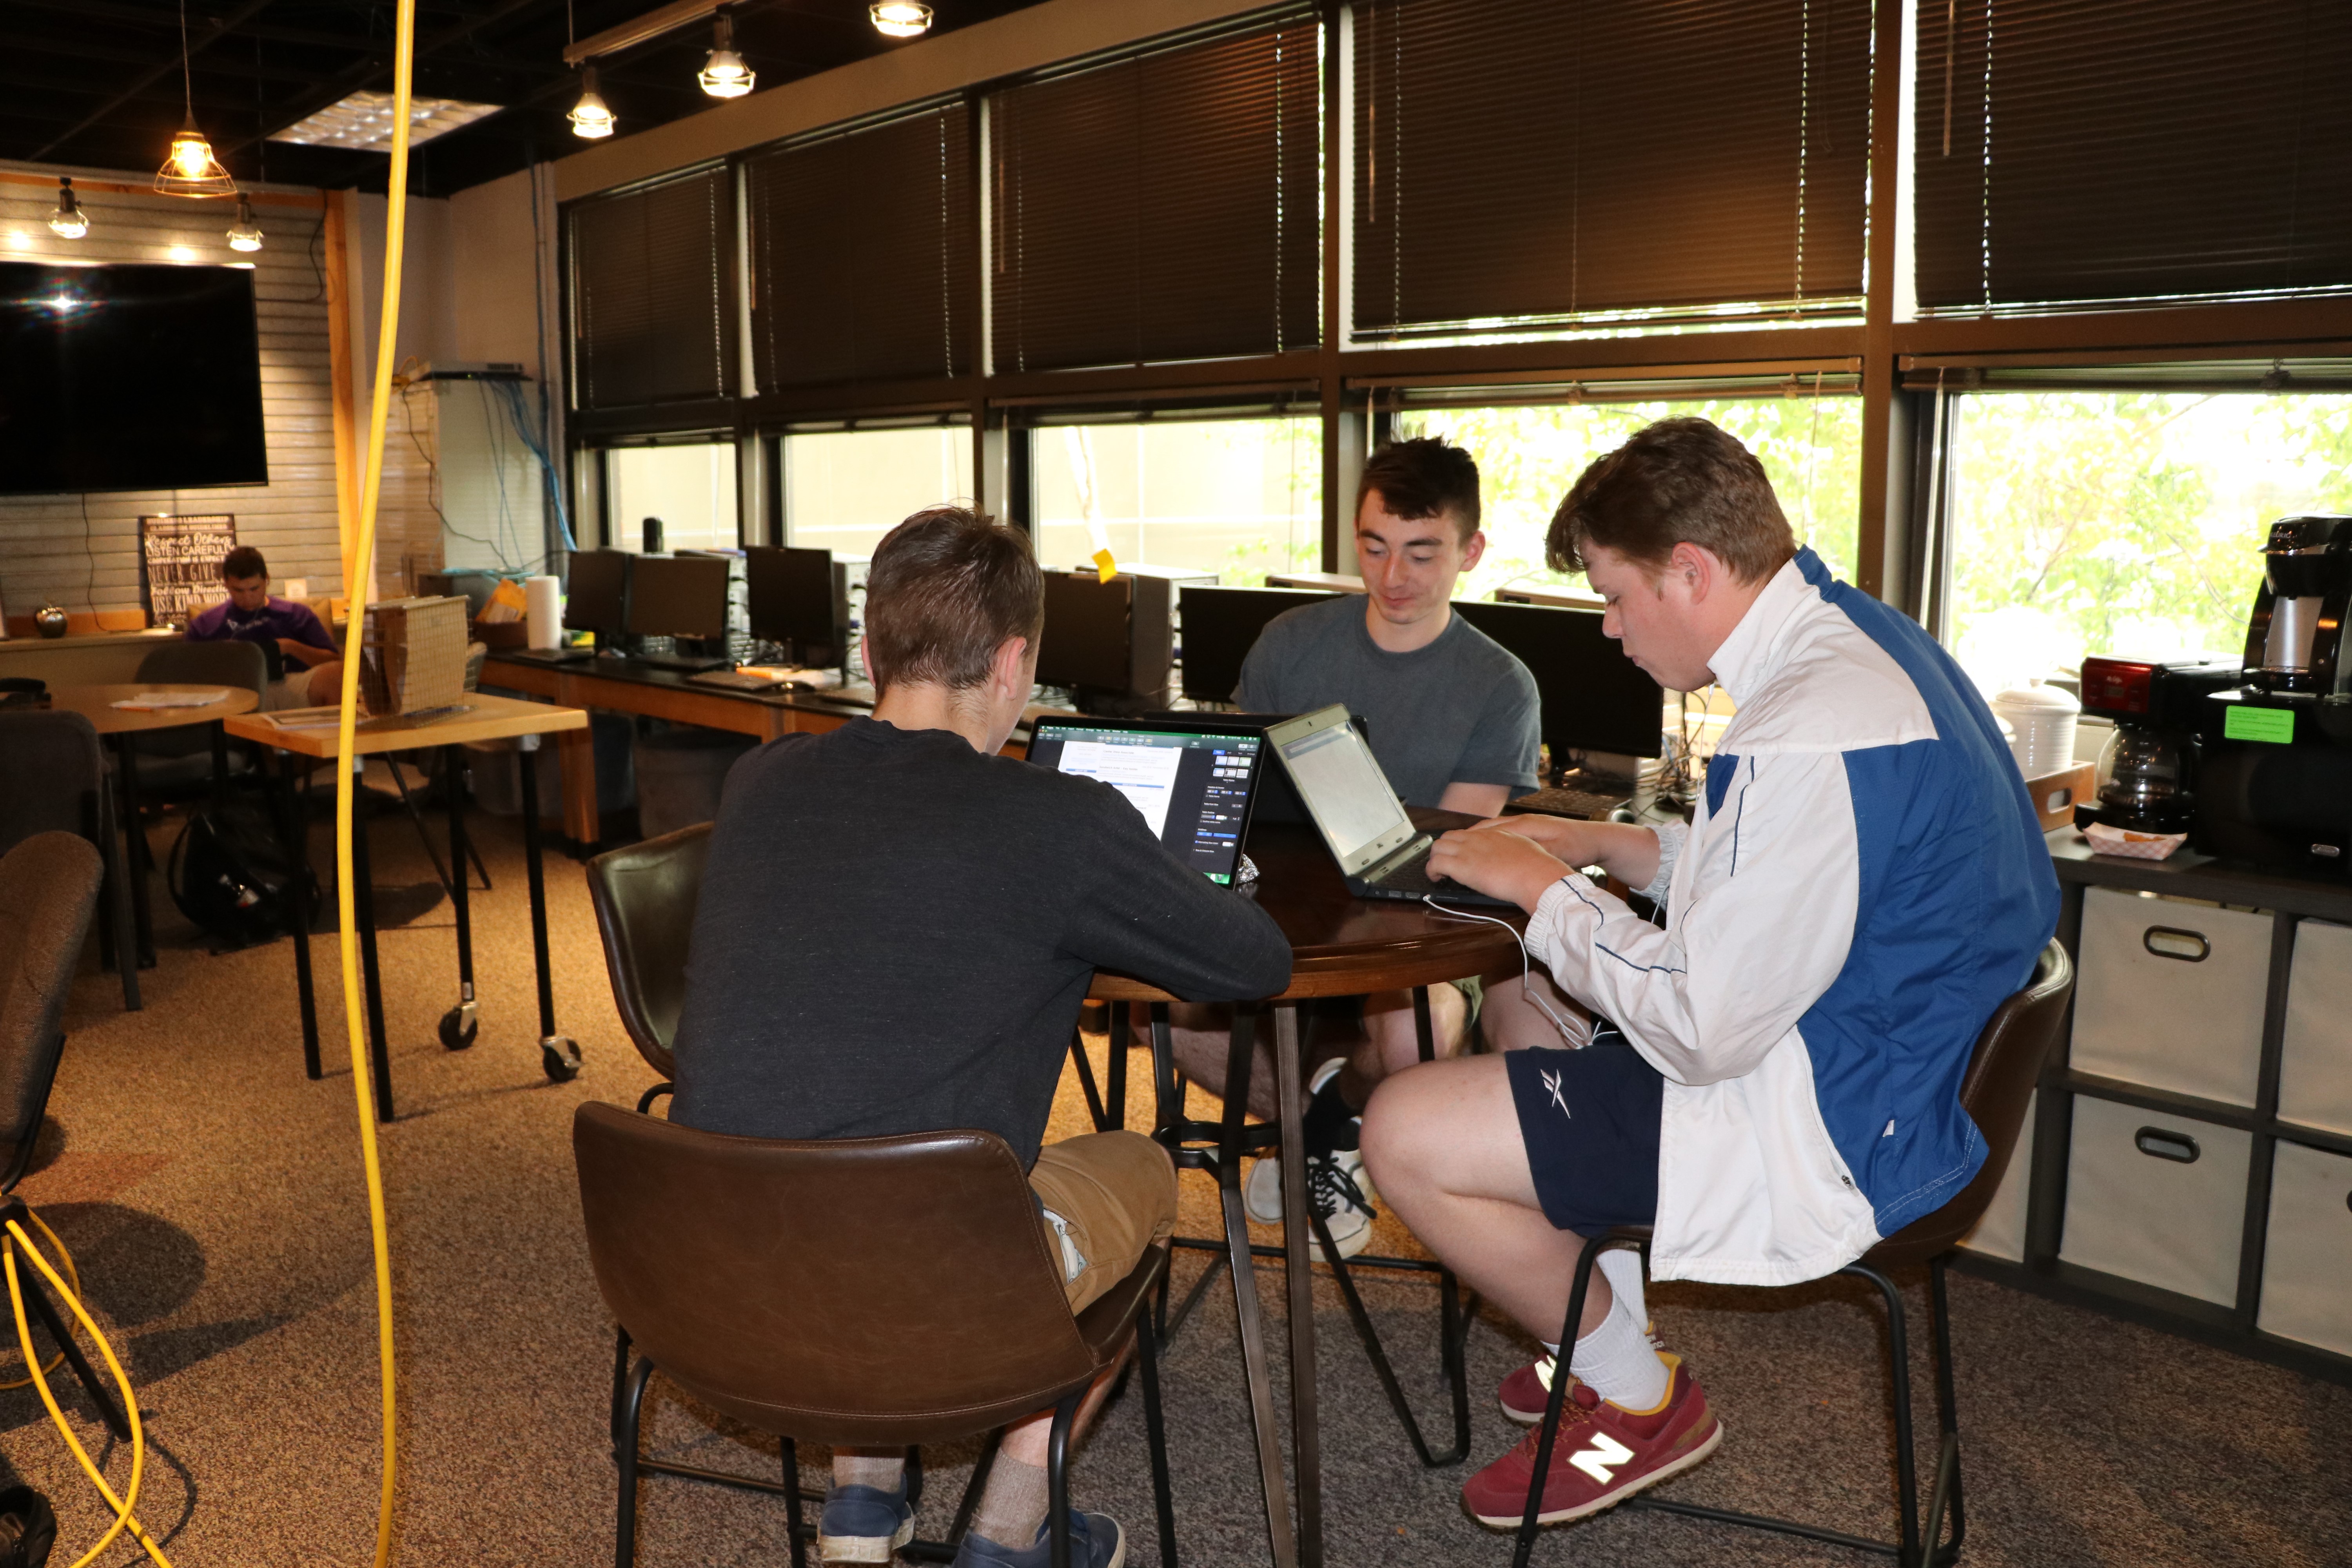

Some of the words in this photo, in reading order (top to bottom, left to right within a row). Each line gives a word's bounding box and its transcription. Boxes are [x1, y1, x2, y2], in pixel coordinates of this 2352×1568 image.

[145, 546, 180, 557] LISTEN
[200, 555, 226, 563] EXPECT
[148, 563, 183, 583] NEVER
[190, 562, 218, 581] GIVE
[152, 595, 173, 612] USE
[1567, 1431, 1635, 1485] N
